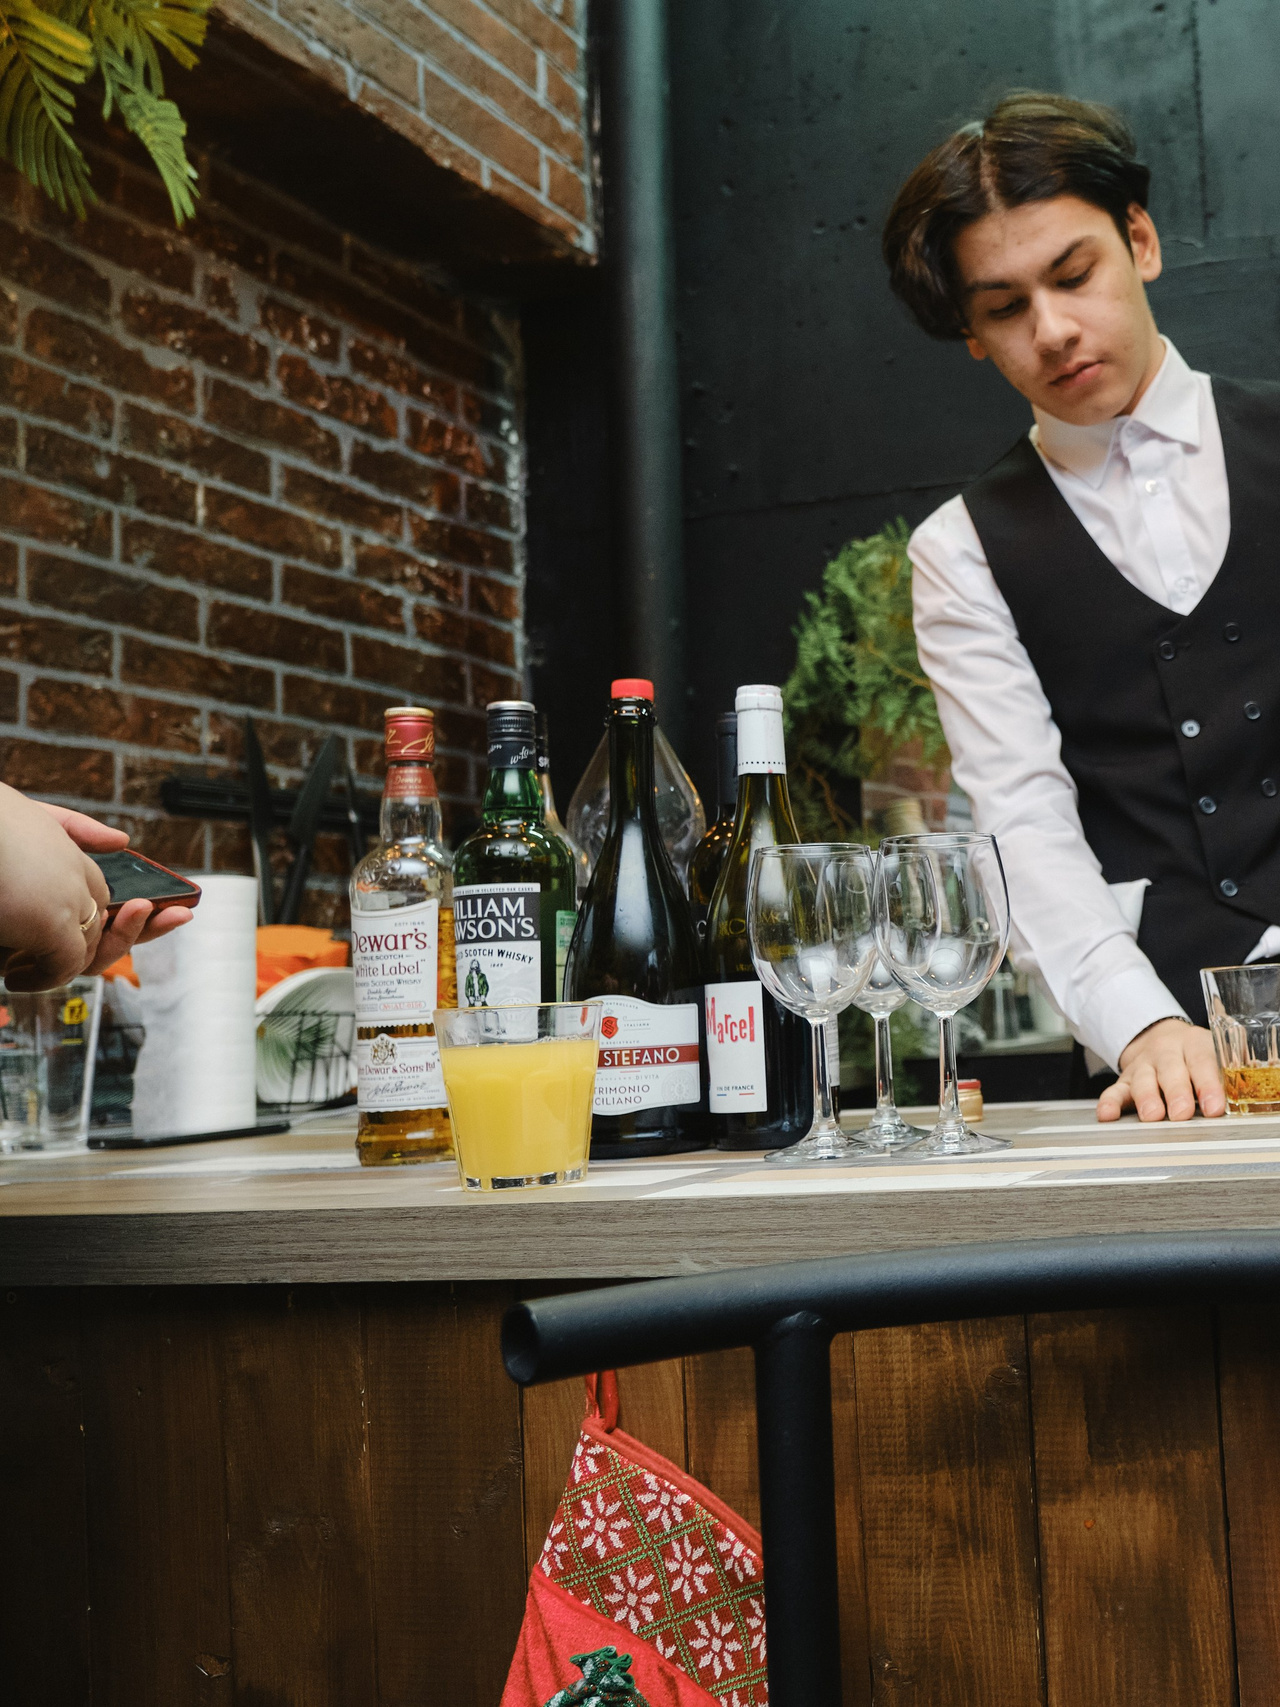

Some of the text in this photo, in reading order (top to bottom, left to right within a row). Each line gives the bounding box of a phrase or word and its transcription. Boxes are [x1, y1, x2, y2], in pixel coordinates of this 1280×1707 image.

[464, 948, 494, 958] SCOTCH
[497, 948, 534, 964] WHISKY
[381, 960, 419, 977] Label
[705, 996, 755, 1044] Marcel
[603, 1047, 680, 1066] STEFANO
[391, 1065, 398, 1074] &
[399, 1062, 424, 1075] Sons
